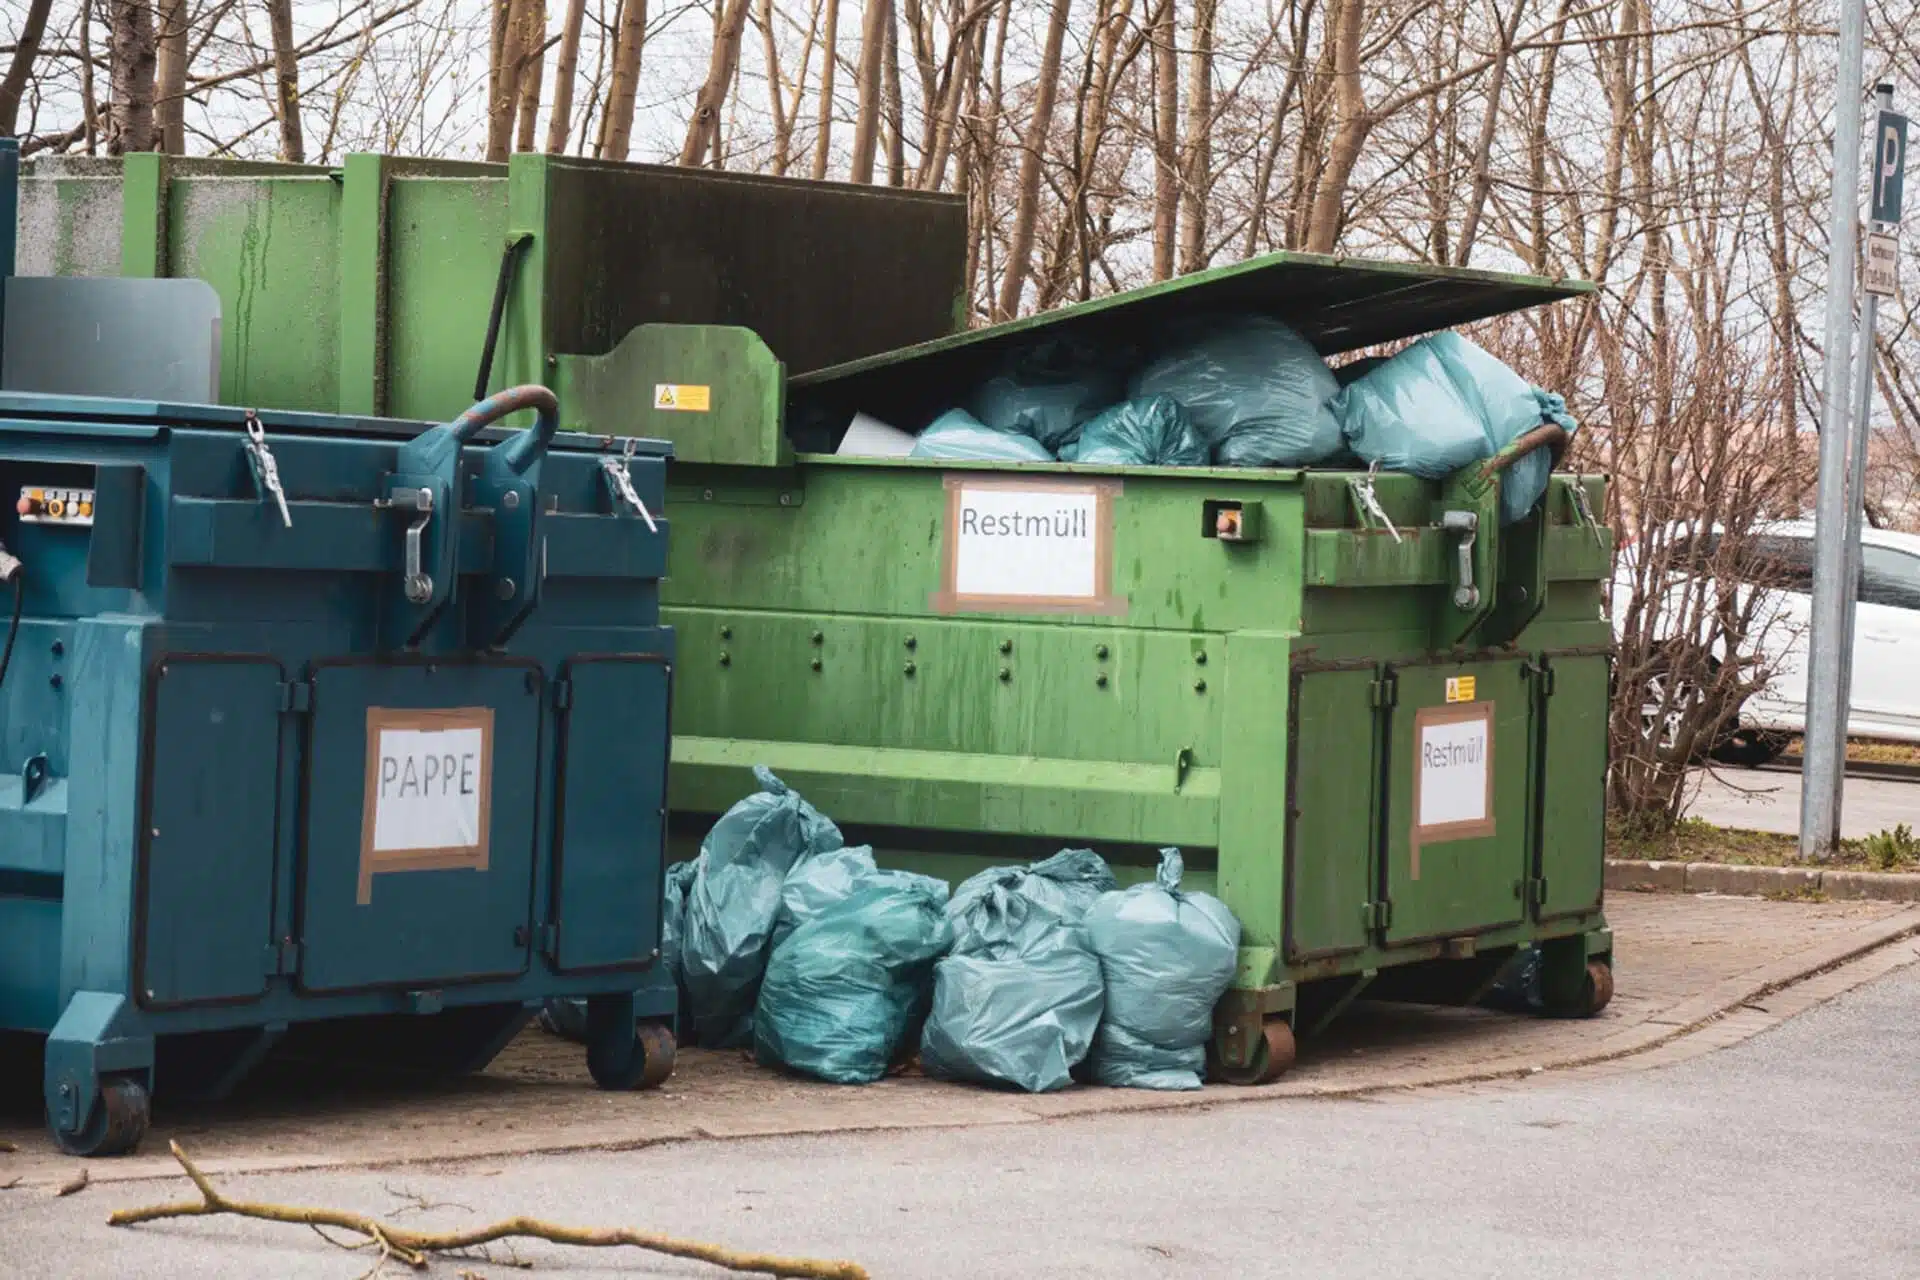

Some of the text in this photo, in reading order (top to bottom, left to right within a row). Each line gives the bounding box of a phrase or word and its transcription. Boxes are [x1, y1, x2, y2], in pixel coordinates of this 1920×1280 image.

[1880, 126, 1899, 208] P
[962, 507, 1086, 538] Restmüll
[1423, 735, 1484, 769] Restmüll
[381, 752, 474, 798] PAPPE
